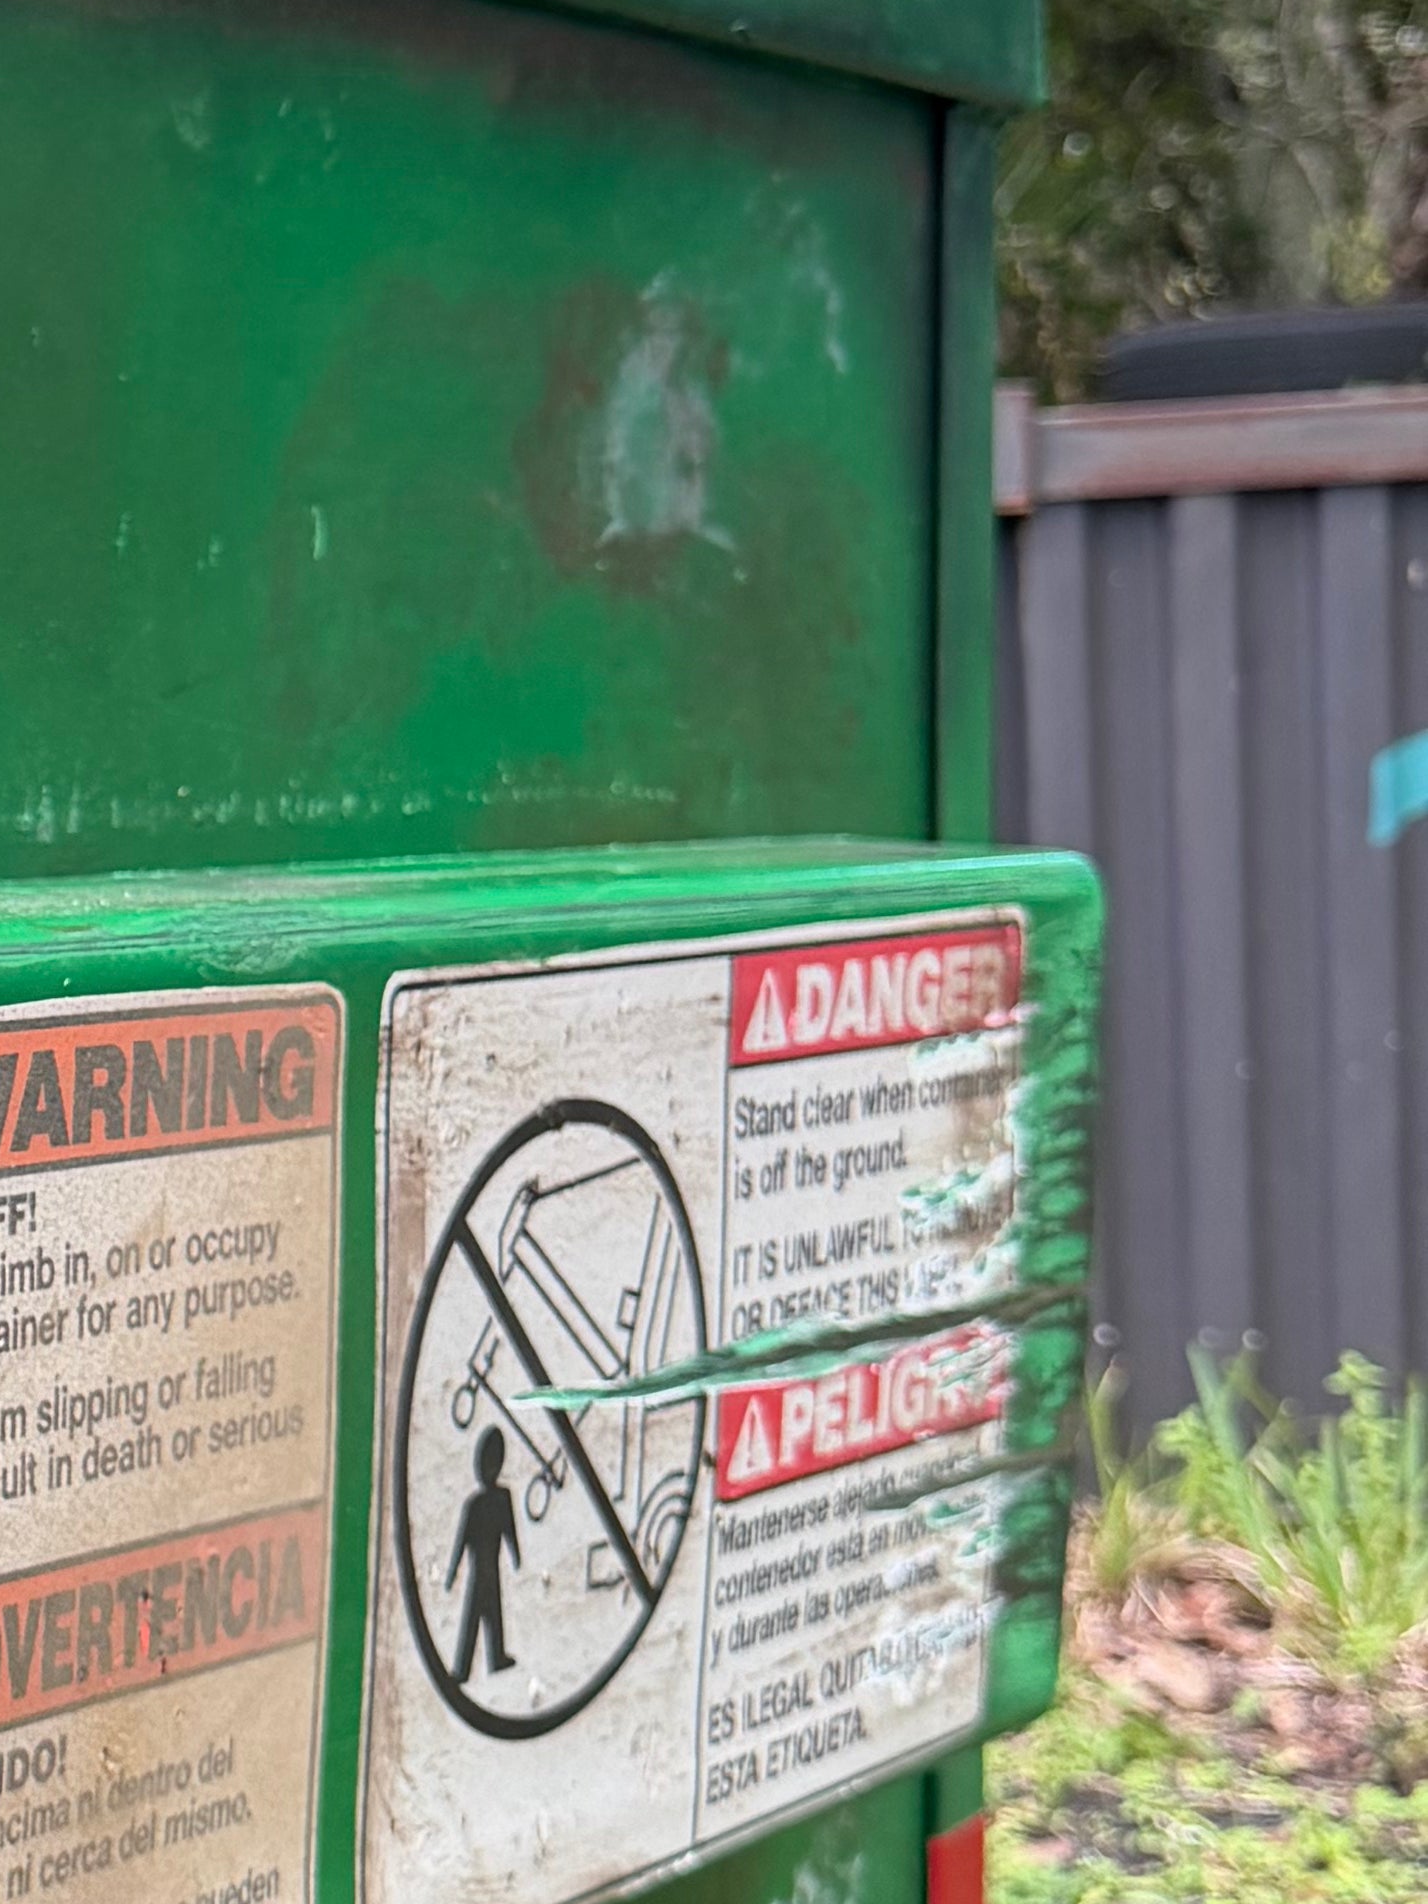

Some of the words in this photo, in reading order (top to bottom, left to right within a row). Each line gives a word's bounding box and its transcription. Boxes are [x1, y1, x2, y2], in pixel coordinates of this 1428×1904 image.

[794, 945, 1006, 1044] DANGER
[734, 1090, 795, 1139] Stand
[802, 1081, 853, 1124] clear
[859, 1071, 913, 1116] when
[734, 1151, 752, 1197] is
[760, 1143, 788, 1189] off
[795, 1141, 828, 1187] the
[833, 1130, 907, 1192] ground.
[64, 1242, 97, 1286] in,
[106, 1244, 141, 1278] on
[149, 1236, 176, 1269] or
[185, 1219, 280, 1268] occupy
[732, 1243, 753, 1288] IT
[758, 1240, 778, 1280] IS
[784, 1214, 894, 1273] UNLAWFUL
[77, 1301, 116, 1336] for
[126, 1289, 174, 1334] any
[184, 1267, 300, 1327] purpose.
[732, 1298, 764, 1342] OR
[857, 1267, 898, 1314] THIS
[37, 1373, 146, 1435] slipping
[158, 1369, 186, 1402] or
[195, 1350, 276, 1396] falling
[48, 1451, 72, 1490] in
[82, 1429, 163, 1481] death
[171, 1423, 199, 1458] or
[208, 1402, 304, 1453] serious
[717, 1495, 829, 1555] Mantenerse
[833, 1466, 896, 1523] alejado
[715, 1540, 822, 1608] contenedor
[869, 1523, 890, 1550] en
[711, 1628, 723, 1669] y
[729, 1601, 799, 1653] durante
[804, 1587, 830, 1626] las
[708, 1699, 736, 1746] ES
[742, 1672, 814, 1734] ILEGAL
[78, 1786, 102, 1826] ni
[110, 1760, 190, 1818] dentro
[198, 1736, 235, 1787] del
[706, 1747, 759, 1805] ESTA
[765, 1706, 867, 1779] ETIQUETA.
[7, 1852, 32, 1894] ni
[38, 1836, 111, 1884] cerca
[119, 1816, 157, 1866] del
[165, 1789, 252, 1849] mismo.
